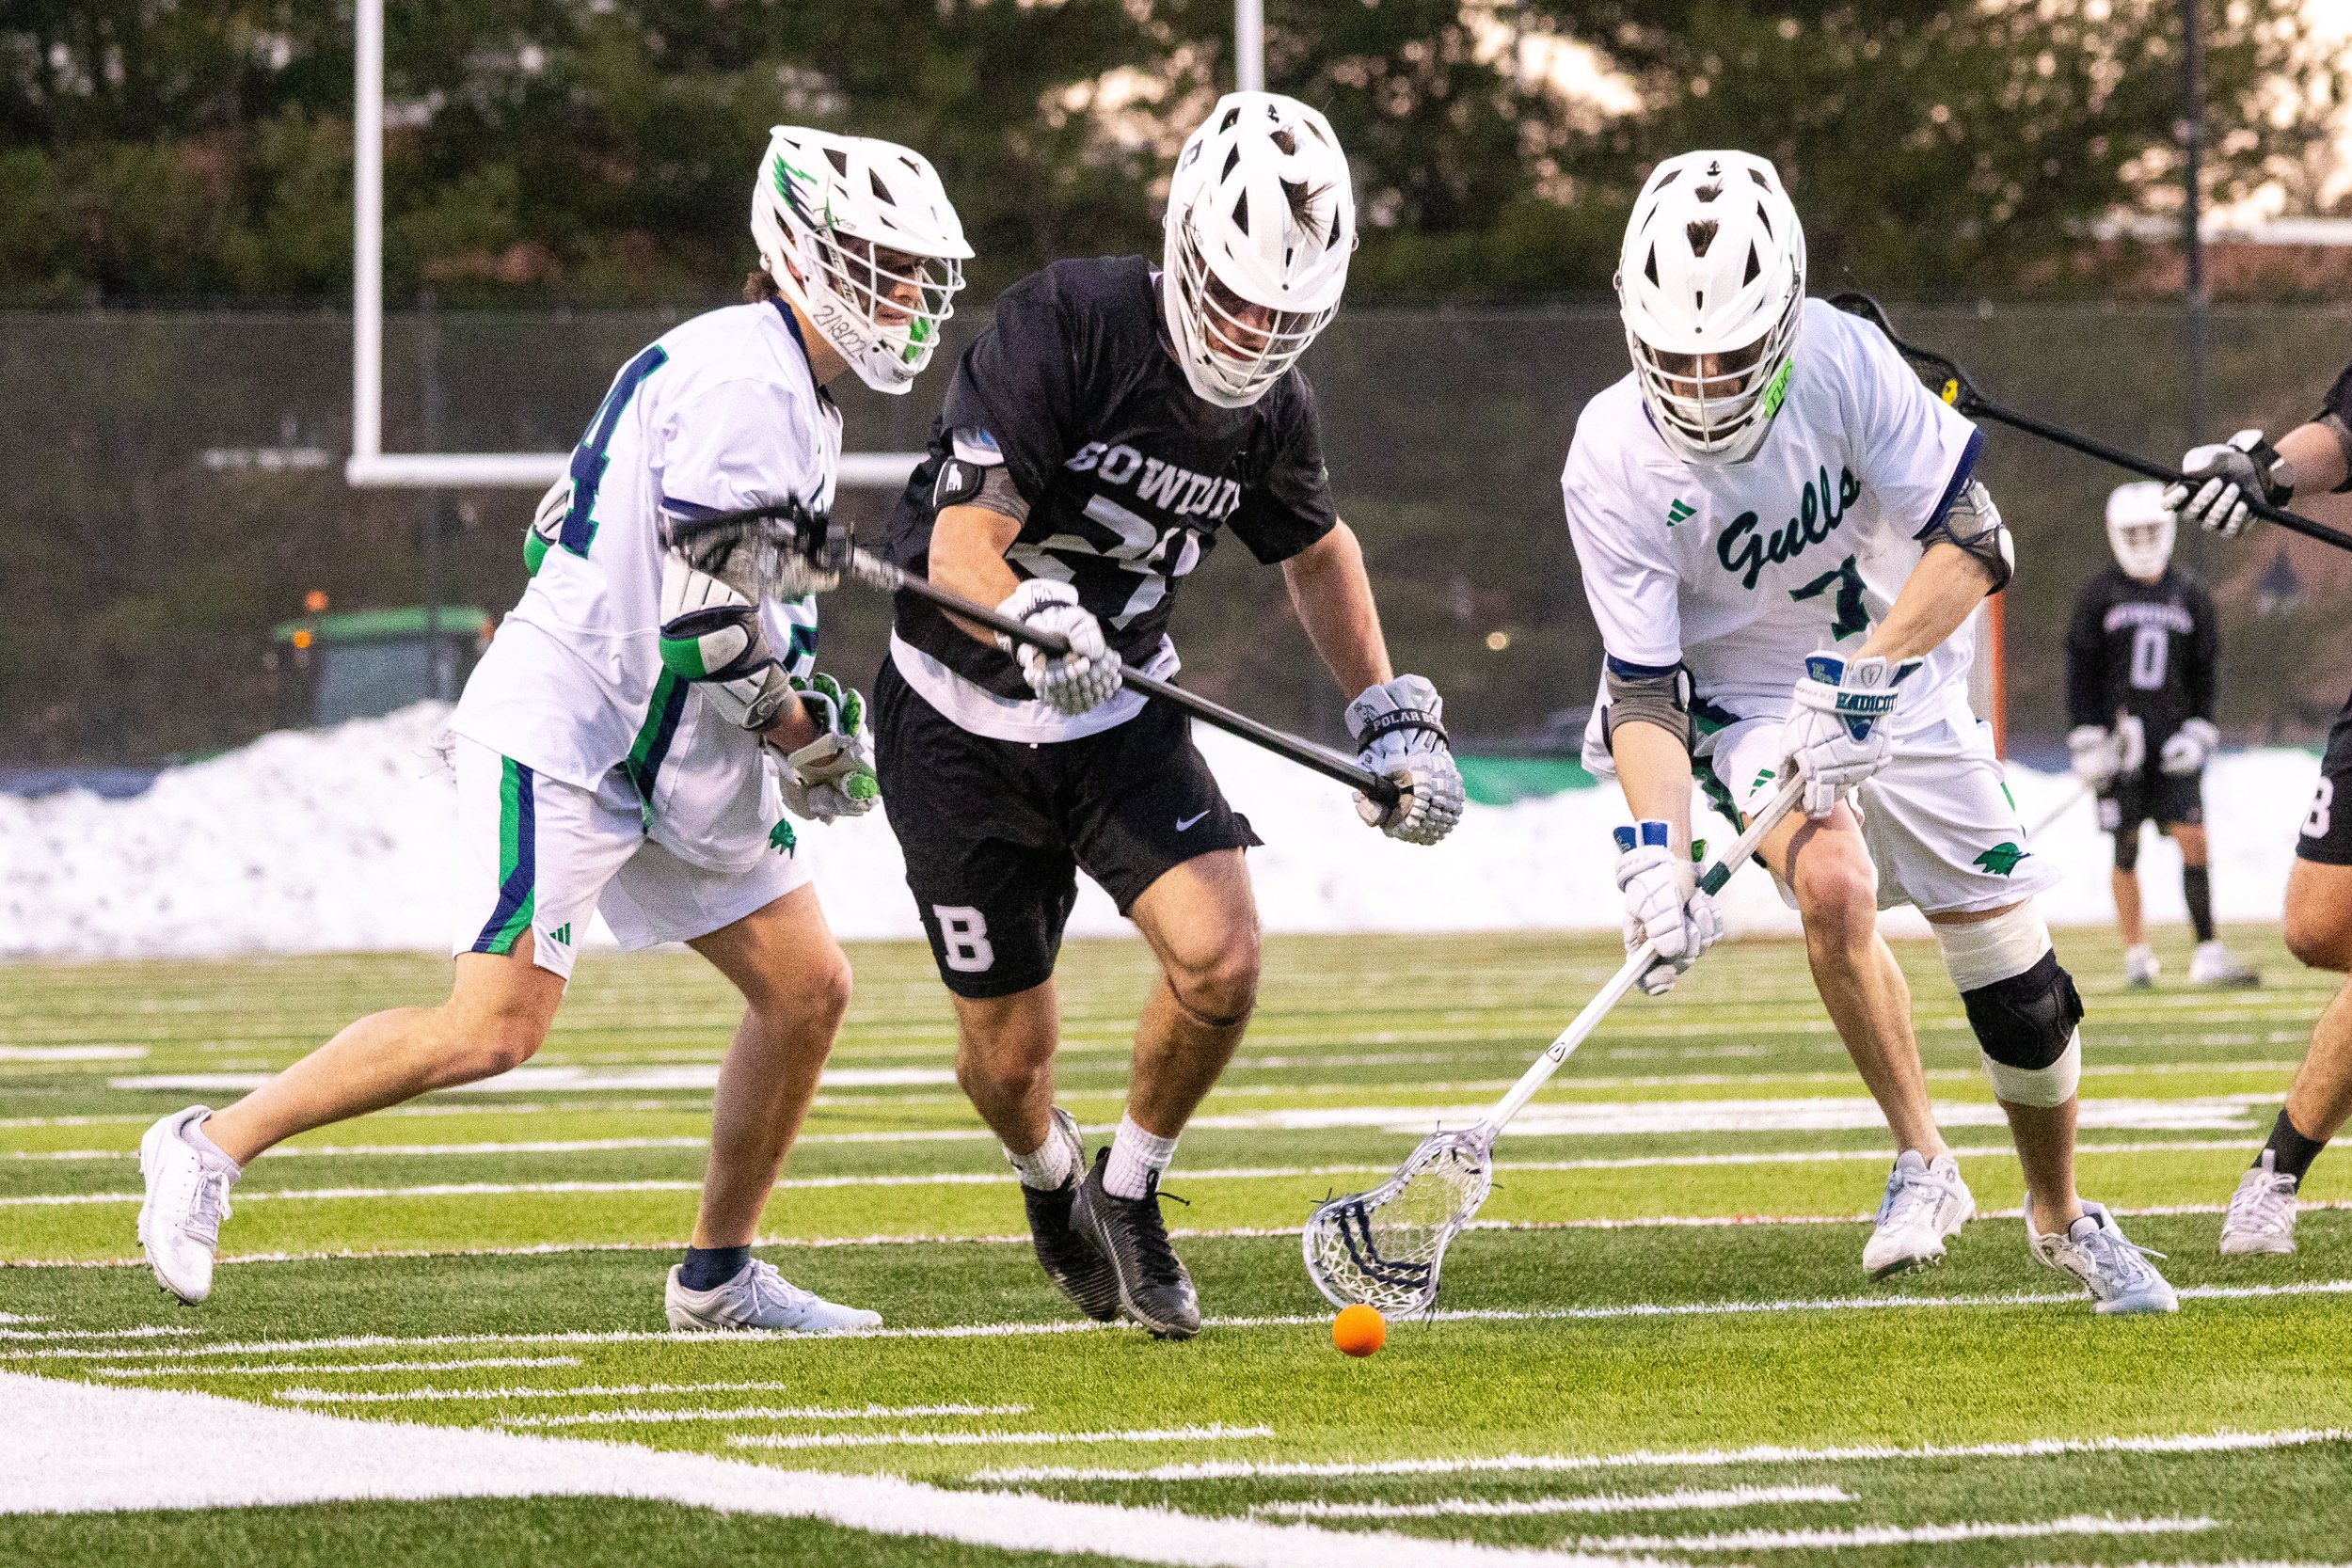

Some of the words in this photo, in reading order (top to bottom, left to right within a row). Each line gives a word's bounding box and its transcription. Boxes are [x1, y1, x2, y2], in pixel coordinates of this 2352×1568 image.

[559, 344, 669, 560] 4
[1717, 465, 1861, 591] Gulls
[1788, 554, 1870, 641] 7
[2131, 626, 2168, 690] 0
[1373, 711, 1421, 731] POLAR
[2301, 776, 2334, 839] B
[932, 904, 994, 972] B
